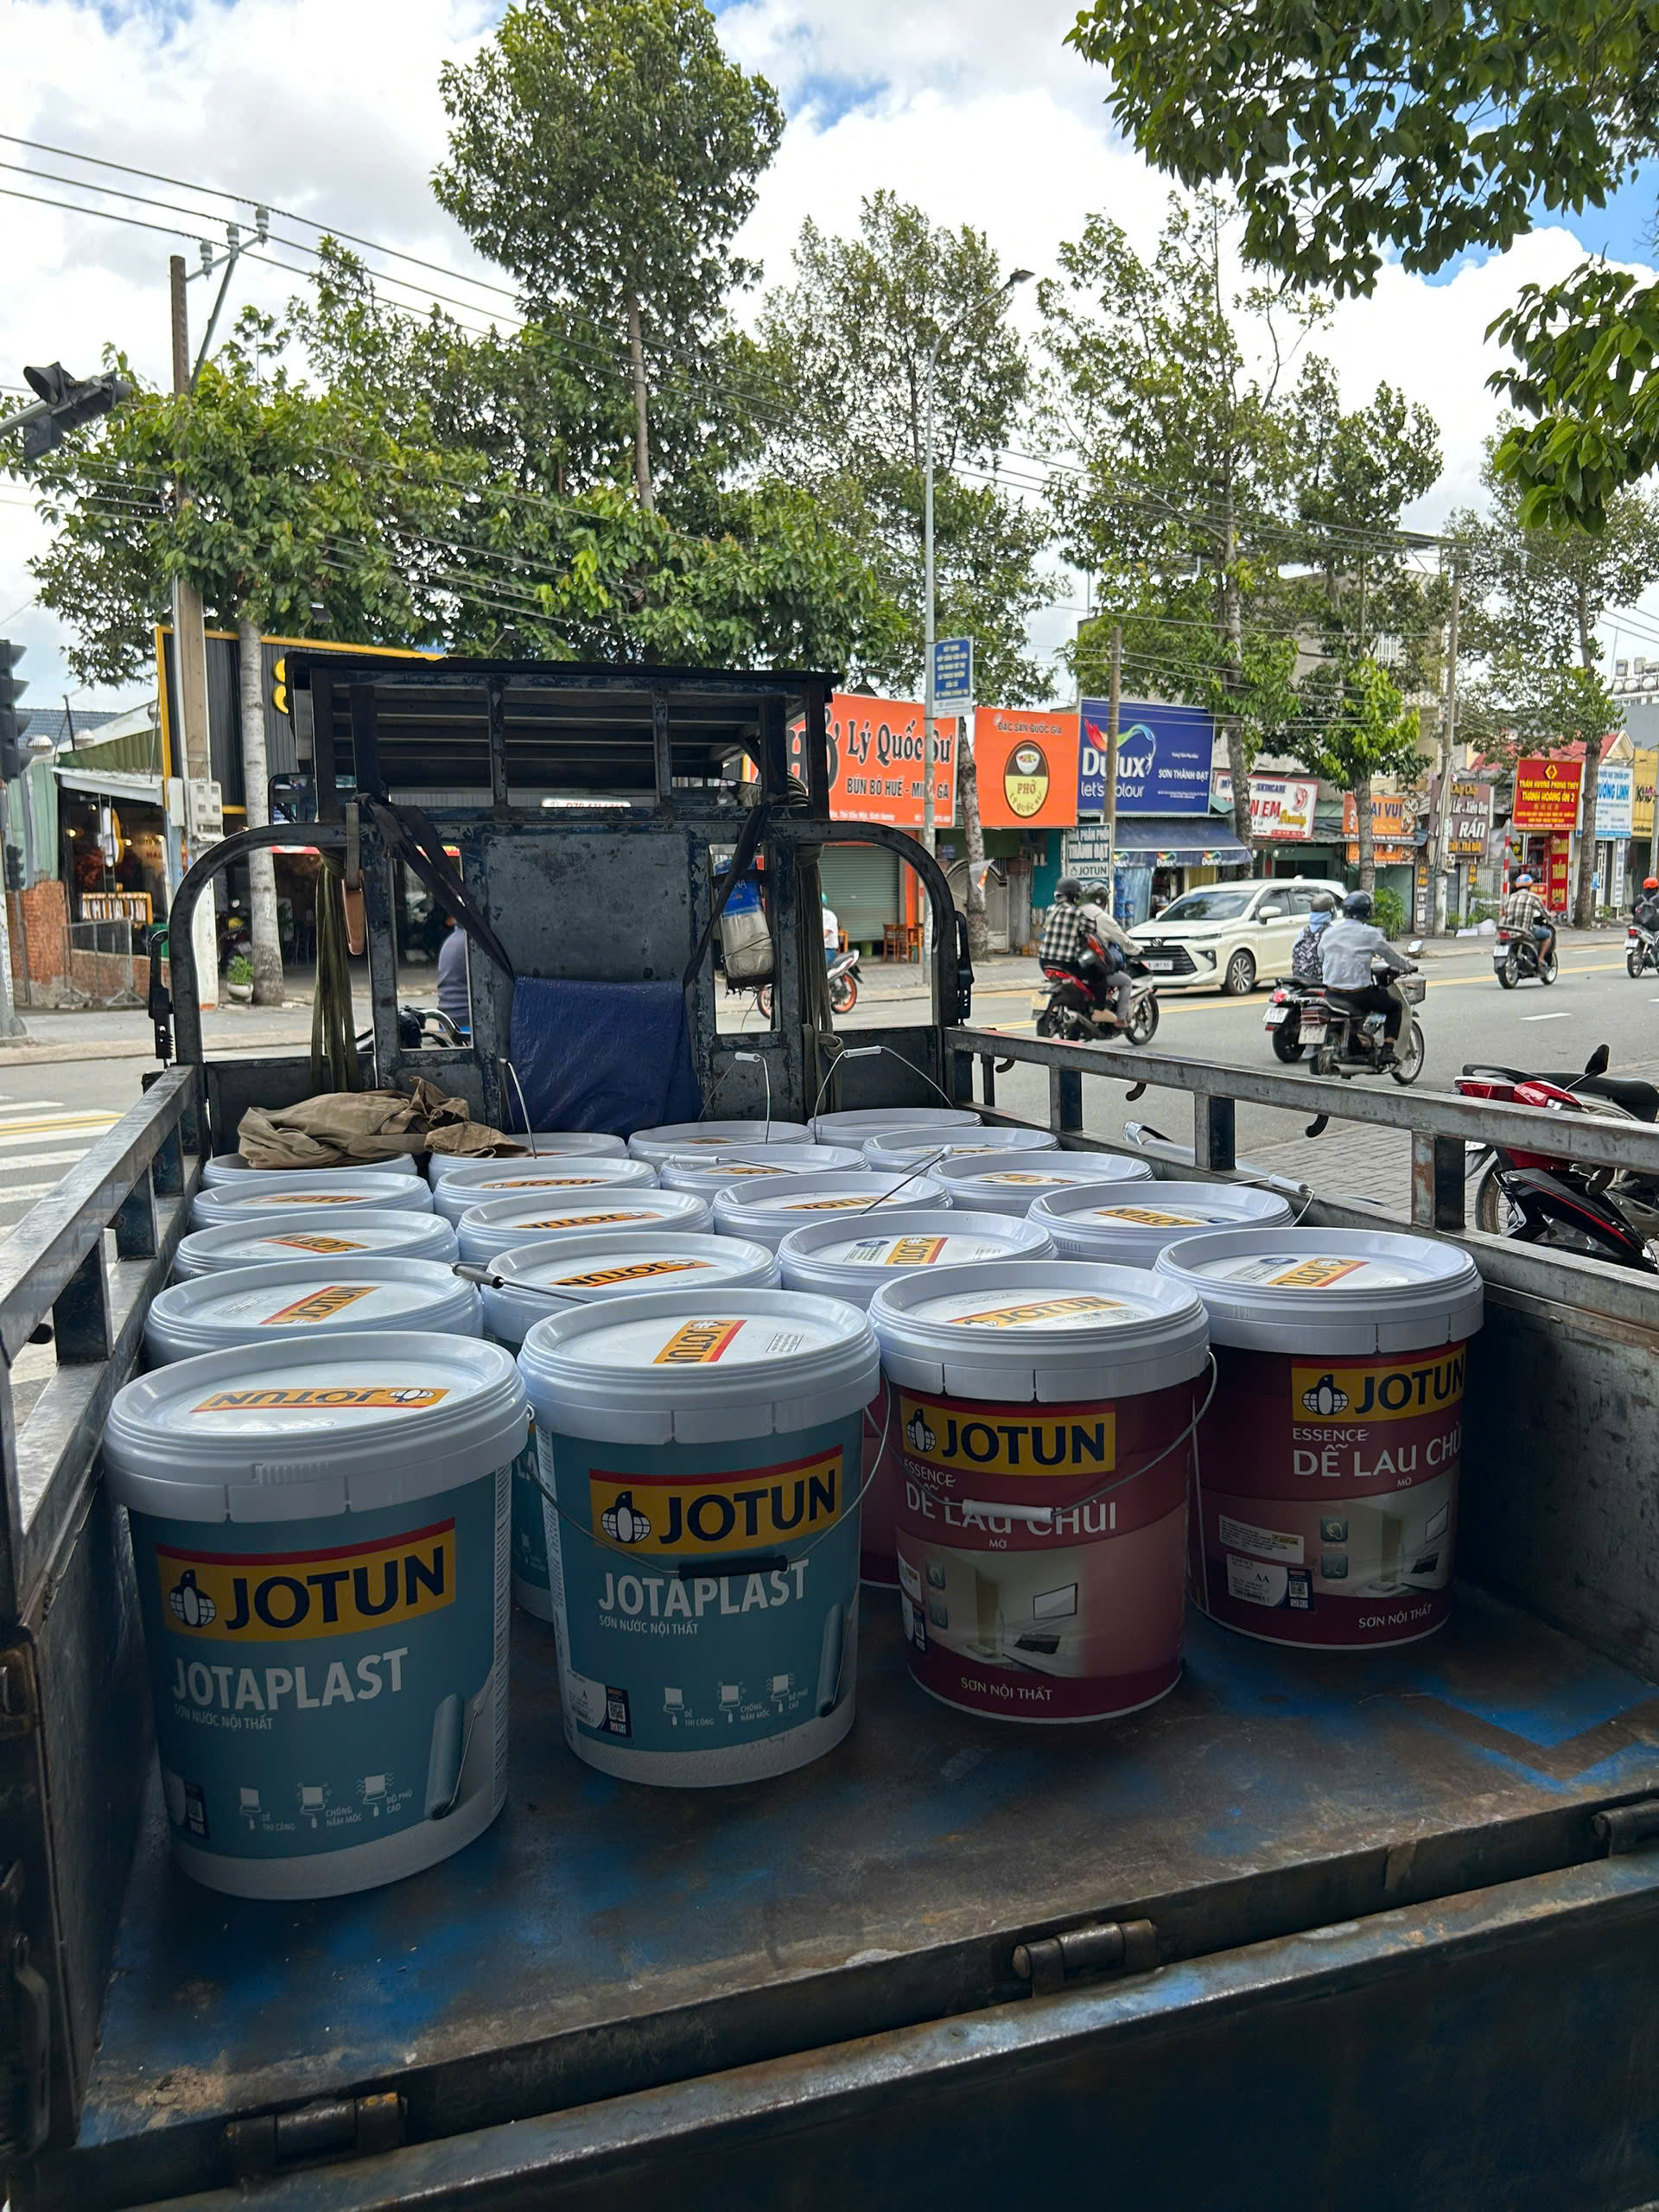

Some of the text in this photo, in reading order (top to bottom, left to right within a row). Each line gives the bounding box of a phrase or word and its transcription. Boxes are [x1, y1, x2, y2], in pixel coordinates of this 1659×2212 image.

[847, 720, 871, 765] Lý
[876, 719, 924, 766] Quốc
[847, 775, 867, 794] BÚN
[869, 776, 882, 795] BÒ
[885, 775, 903, 797] HUẾ
[1081, 781, 1105, 798] let's
[1115, 781, 1145, 798] olour
[1256, 782, 1287, 793] SKINCARE
[1262, 801, 1281, 817] EM
[1079, 866, 1107, 875] JOTUN
[557, 1262, 667, 1287] JOTUN
[1276, 1265, 1338, 1286] JOTU
[289, 1287, 370, 1319] JOTUN
[995, 1298, 1115, 1323] JOTUN
[1355, 1353, 1465, 1414] JOTUN
[209, 1389, 387, 1407] JOTUN
[940, 1419, 1106, 1465] JOTUN
[1293, 1427, 1369, 1442] ESSENCE
[1293, 1421, 1462, 1478] DỄ LAU CHÙ
[905, 1458, 956, 1488] ESSENCE
[658, 1469, 836, 1544] JOTUN
[906, 1480, 940, 1520] DỄ
[225, 1545, 446, 1630] JOTUN
[598, 1558, 810, 1618] JOTAPLAST
[599, 1614, 699, 1637] SƠN NƯỚC NỘI THẤT
[1357, 1602, 1432, 1629] SƠN NỘI THẤT
[173, 1646, 409, 1711] JOTAPLAST
[961, 1676, 1052, 1700] SƠN NỘI THẤT
[192, 1706, 220, 1726] NƯỚC
[221, 1714, 243, 1732] NỘI
[245, 1713, 274, 1730] THẤT
